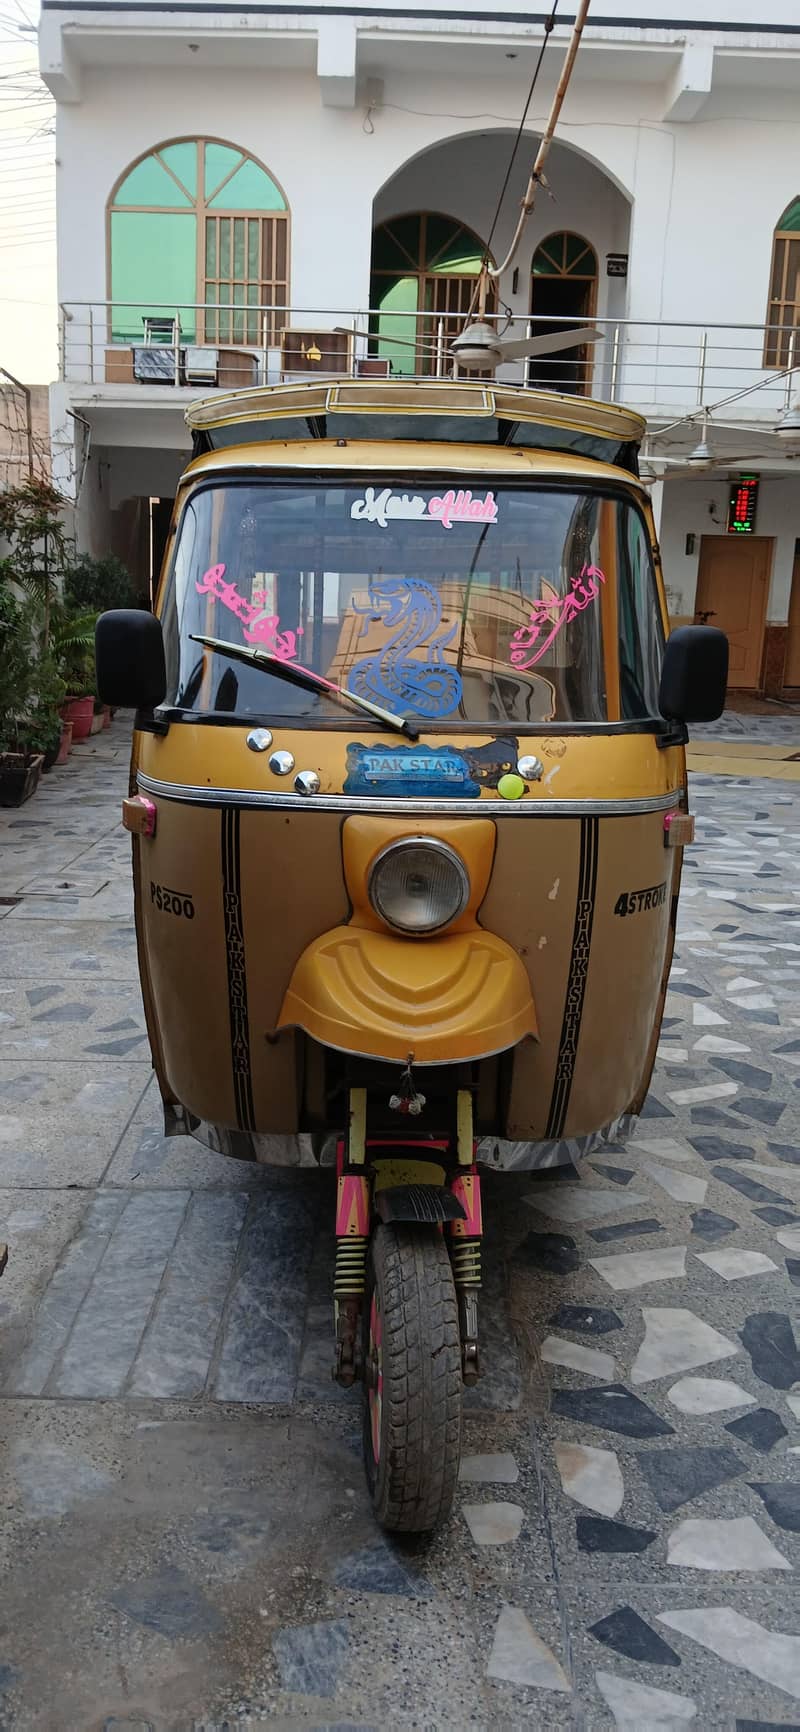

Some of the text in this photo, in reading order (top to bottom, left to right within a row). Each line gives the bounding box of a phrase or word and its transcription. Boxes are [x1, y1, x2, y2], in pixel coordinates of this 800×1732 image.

[428, 489, 499, 529] Allah
[368, 758, 457, 774] PAK STAR
[150, 881, 195, 919] PS200
